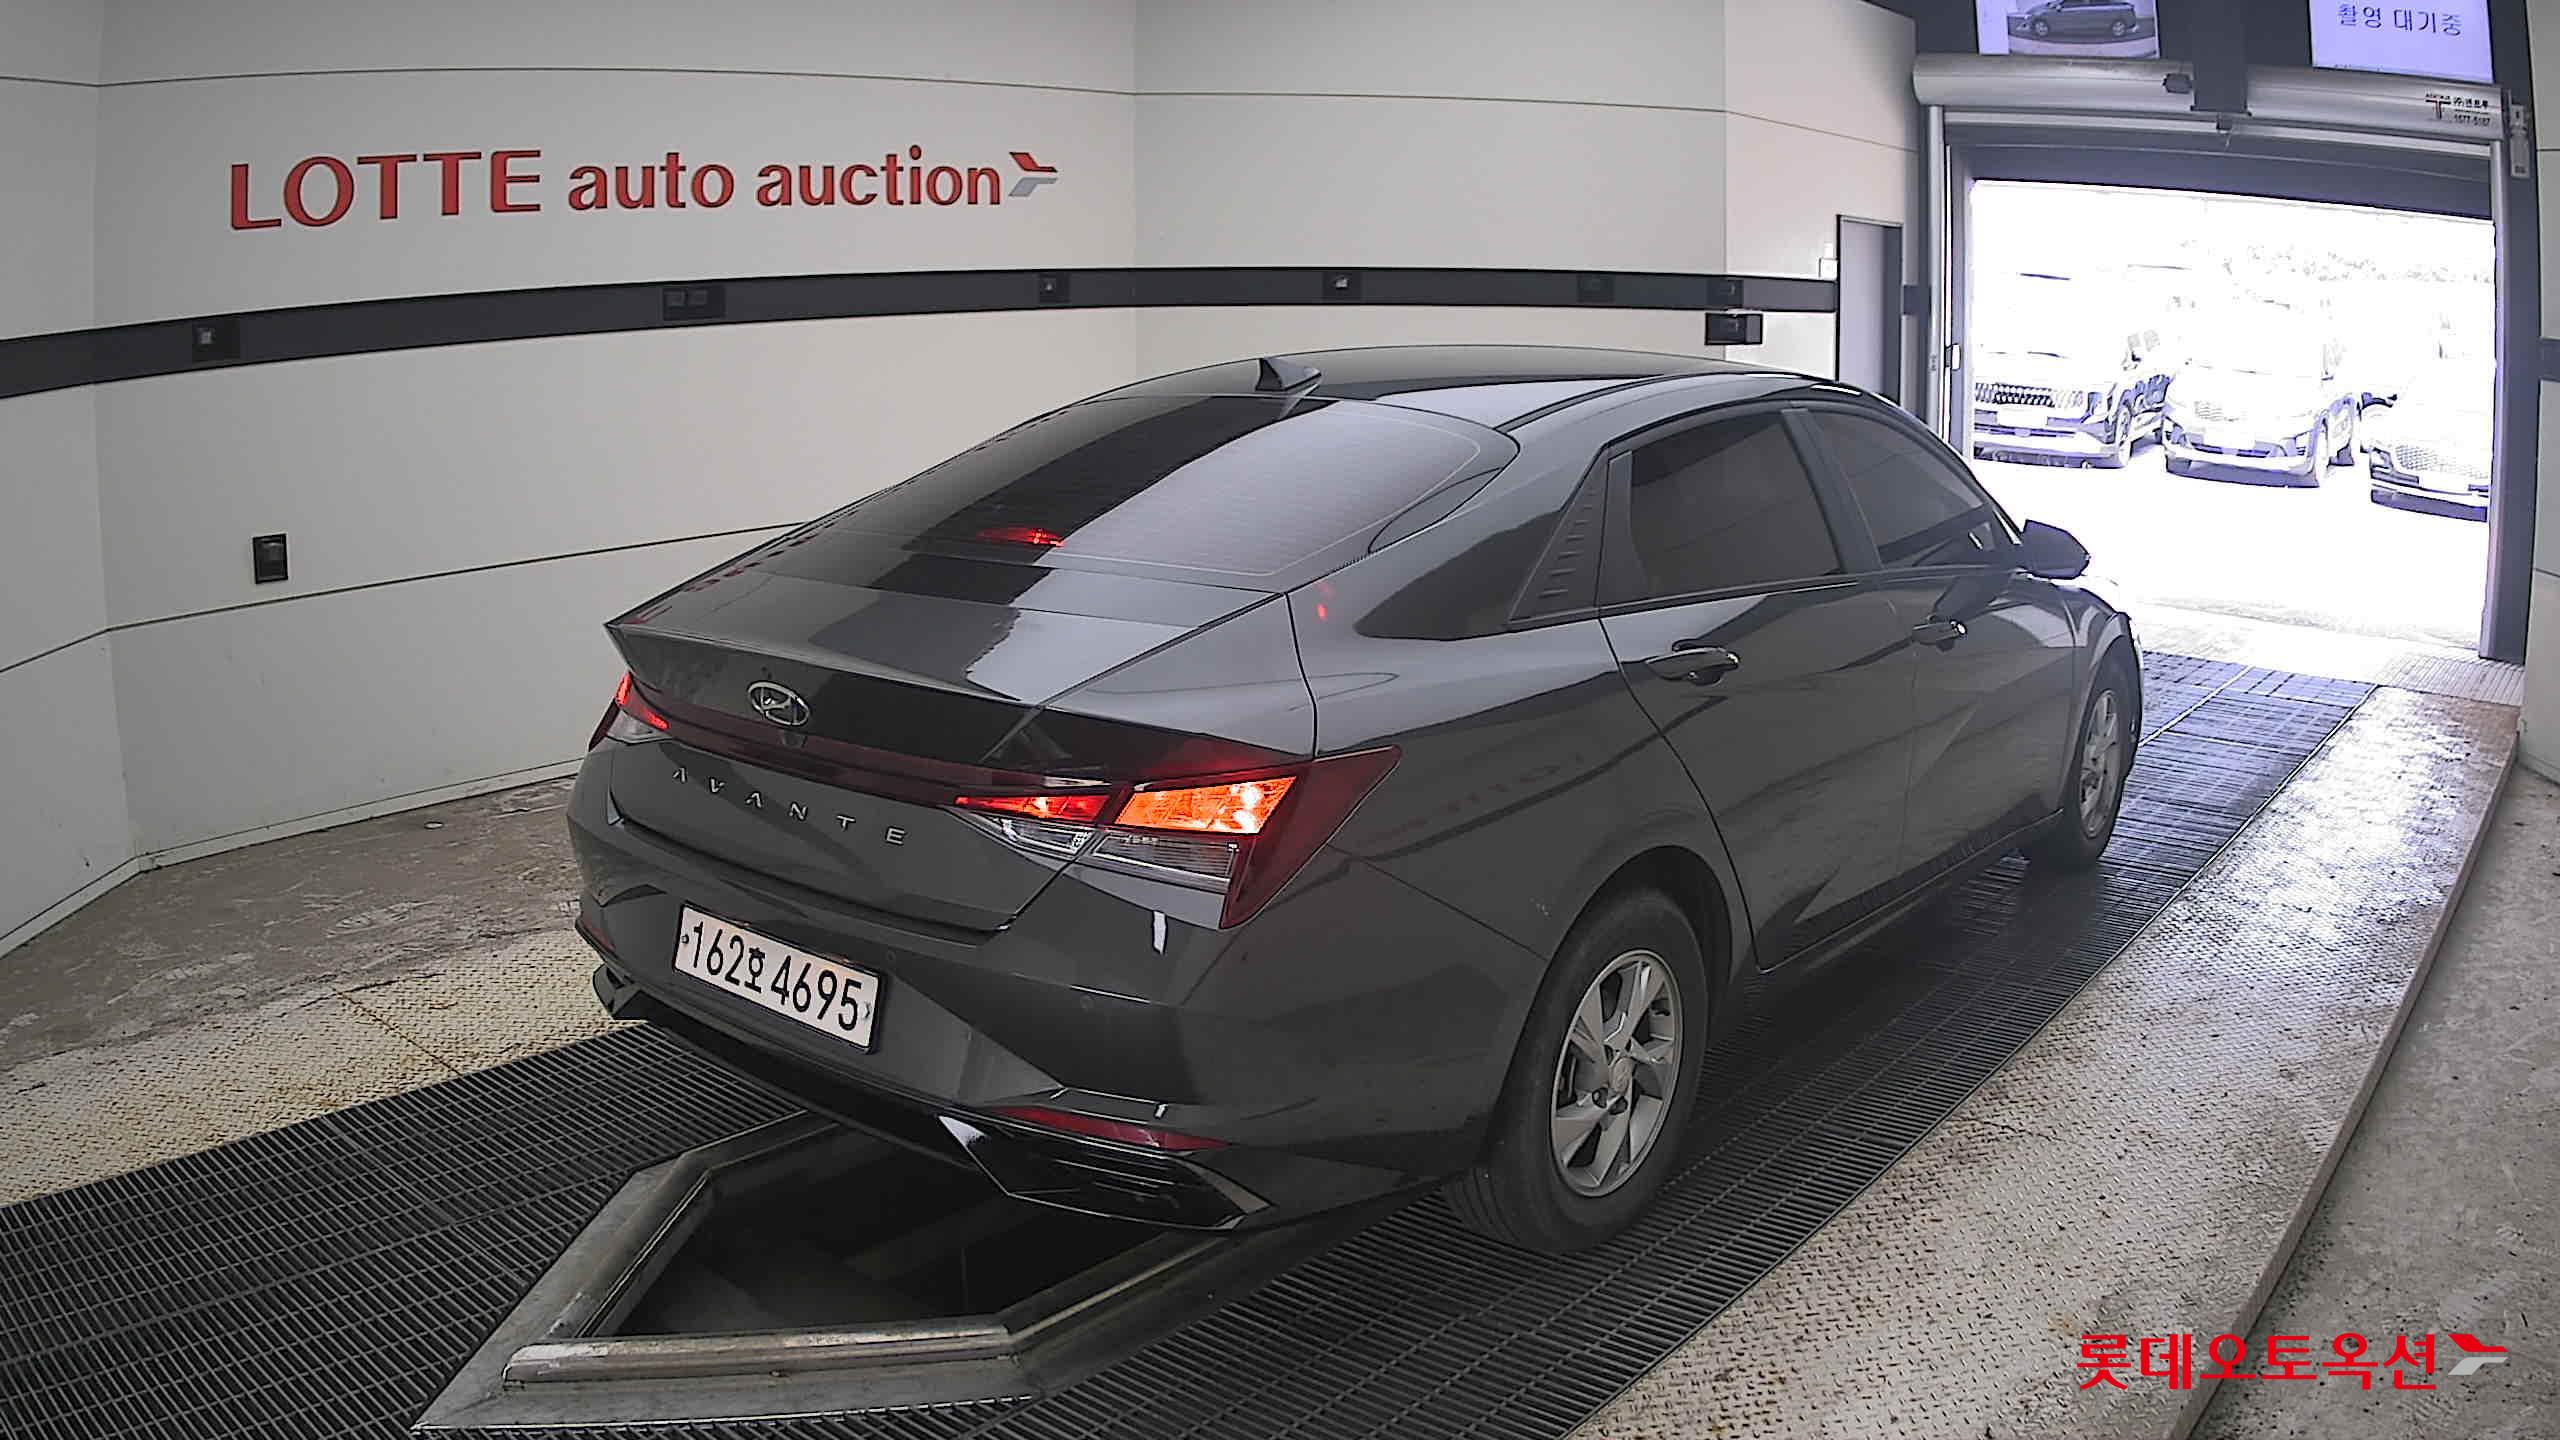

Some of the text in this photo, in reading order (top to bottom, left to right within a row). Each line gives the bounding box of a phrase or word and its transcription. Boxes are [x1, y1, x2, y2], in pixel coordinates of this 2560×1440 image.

[2338, 4, 2462, 36] 촬영 대기중
[229, 145, 1002, 231] LOTTE auto auction
[672, 767, 907, 845] AVANTE
